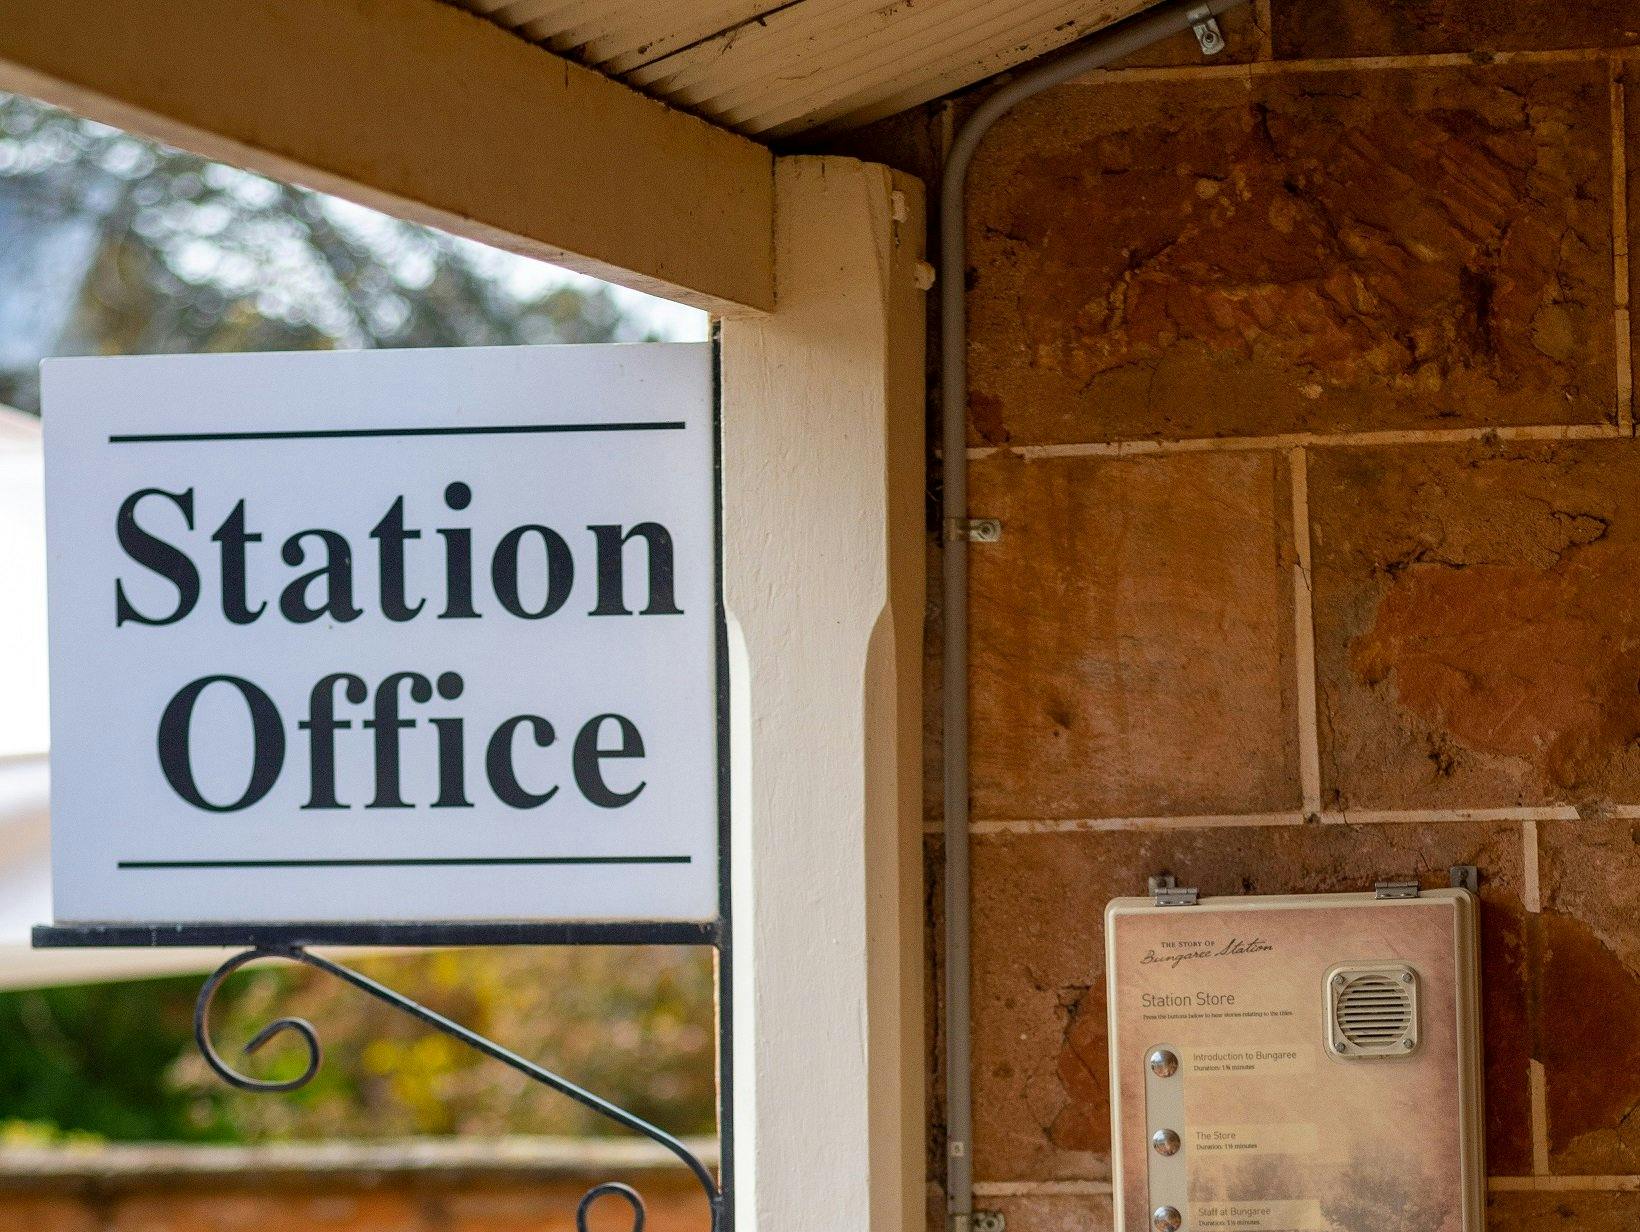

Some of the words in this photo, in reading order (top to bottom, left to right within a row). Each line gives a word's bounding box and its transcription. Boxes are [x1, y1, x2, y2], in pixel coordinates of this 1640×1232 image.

[115, 479, 686, 629] Station
[157, 669, 648, 814] Office
[1140, 950, 1212, 968] Bungaree
[1214, 938, 1273, 956] Station
[1142, 993, 1191, 1007] Station
[1196, 991, 1235, 1006] Store
[1193, 1053, 1243, 1061] Introduction
[1245, 1052, 1254, 1060] to
[1256, 1051, 1297, 1061] Bungaree
[1196, 1132, 1211, 1140] The
[1213, 1131, 1236, 1140] Store
[1198, 1208, 1218, 1216] Staff
[1220, 1208, 1228, 1216] at
[1230, 1207, 1271, 1217] Bungaree
